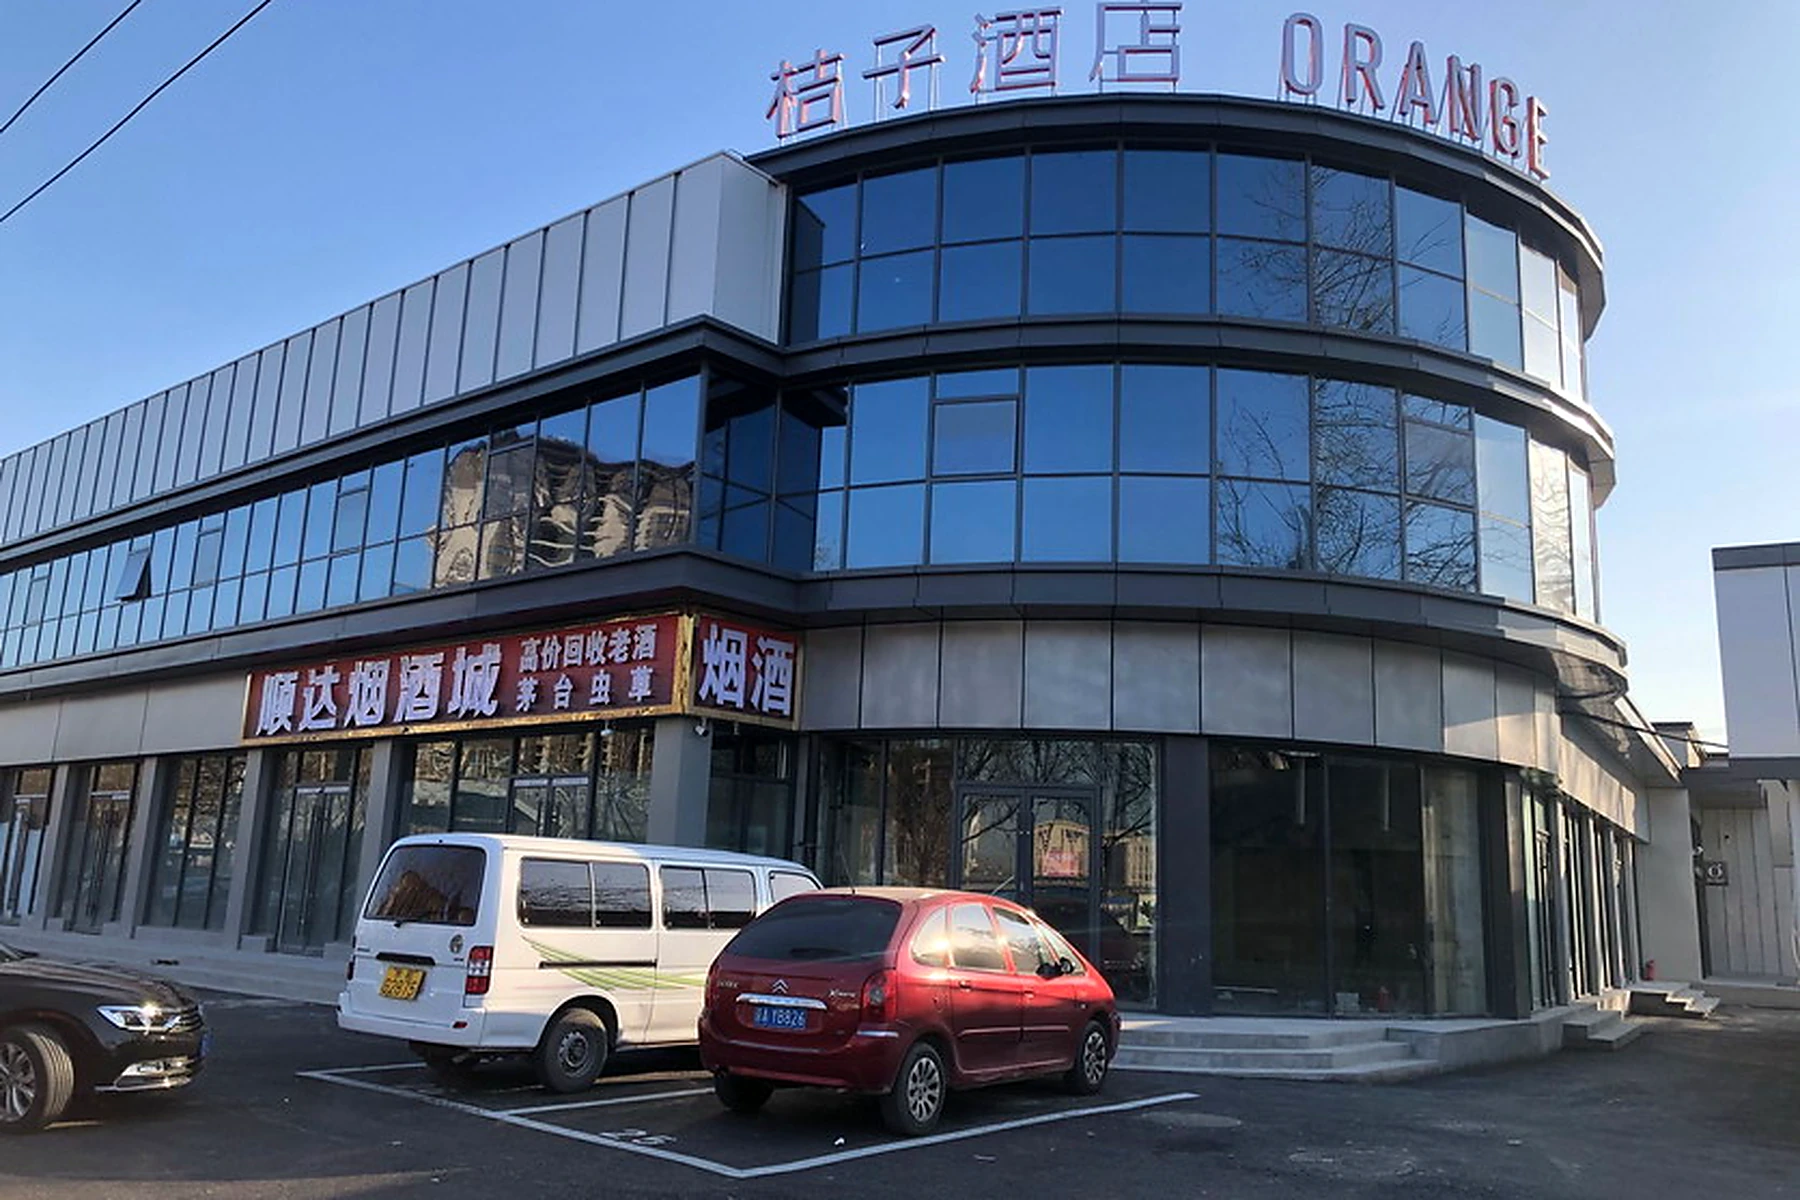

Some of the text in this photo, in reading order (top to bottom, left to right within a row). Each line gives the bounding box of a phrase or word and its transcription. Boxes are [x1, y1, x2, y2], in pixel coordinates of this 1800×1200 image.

[765, 0, 1183, 139] 桔子酒店
[1281, 12, 1550, 180] ORANGE
[255, 643, 502, 736] 顺达烟酒城
[516, 666, 653, 712] 茅台虫草
[519, 624, 657, 673] 高价回收老酒
[699, 624, 794, 716] 烟酒
